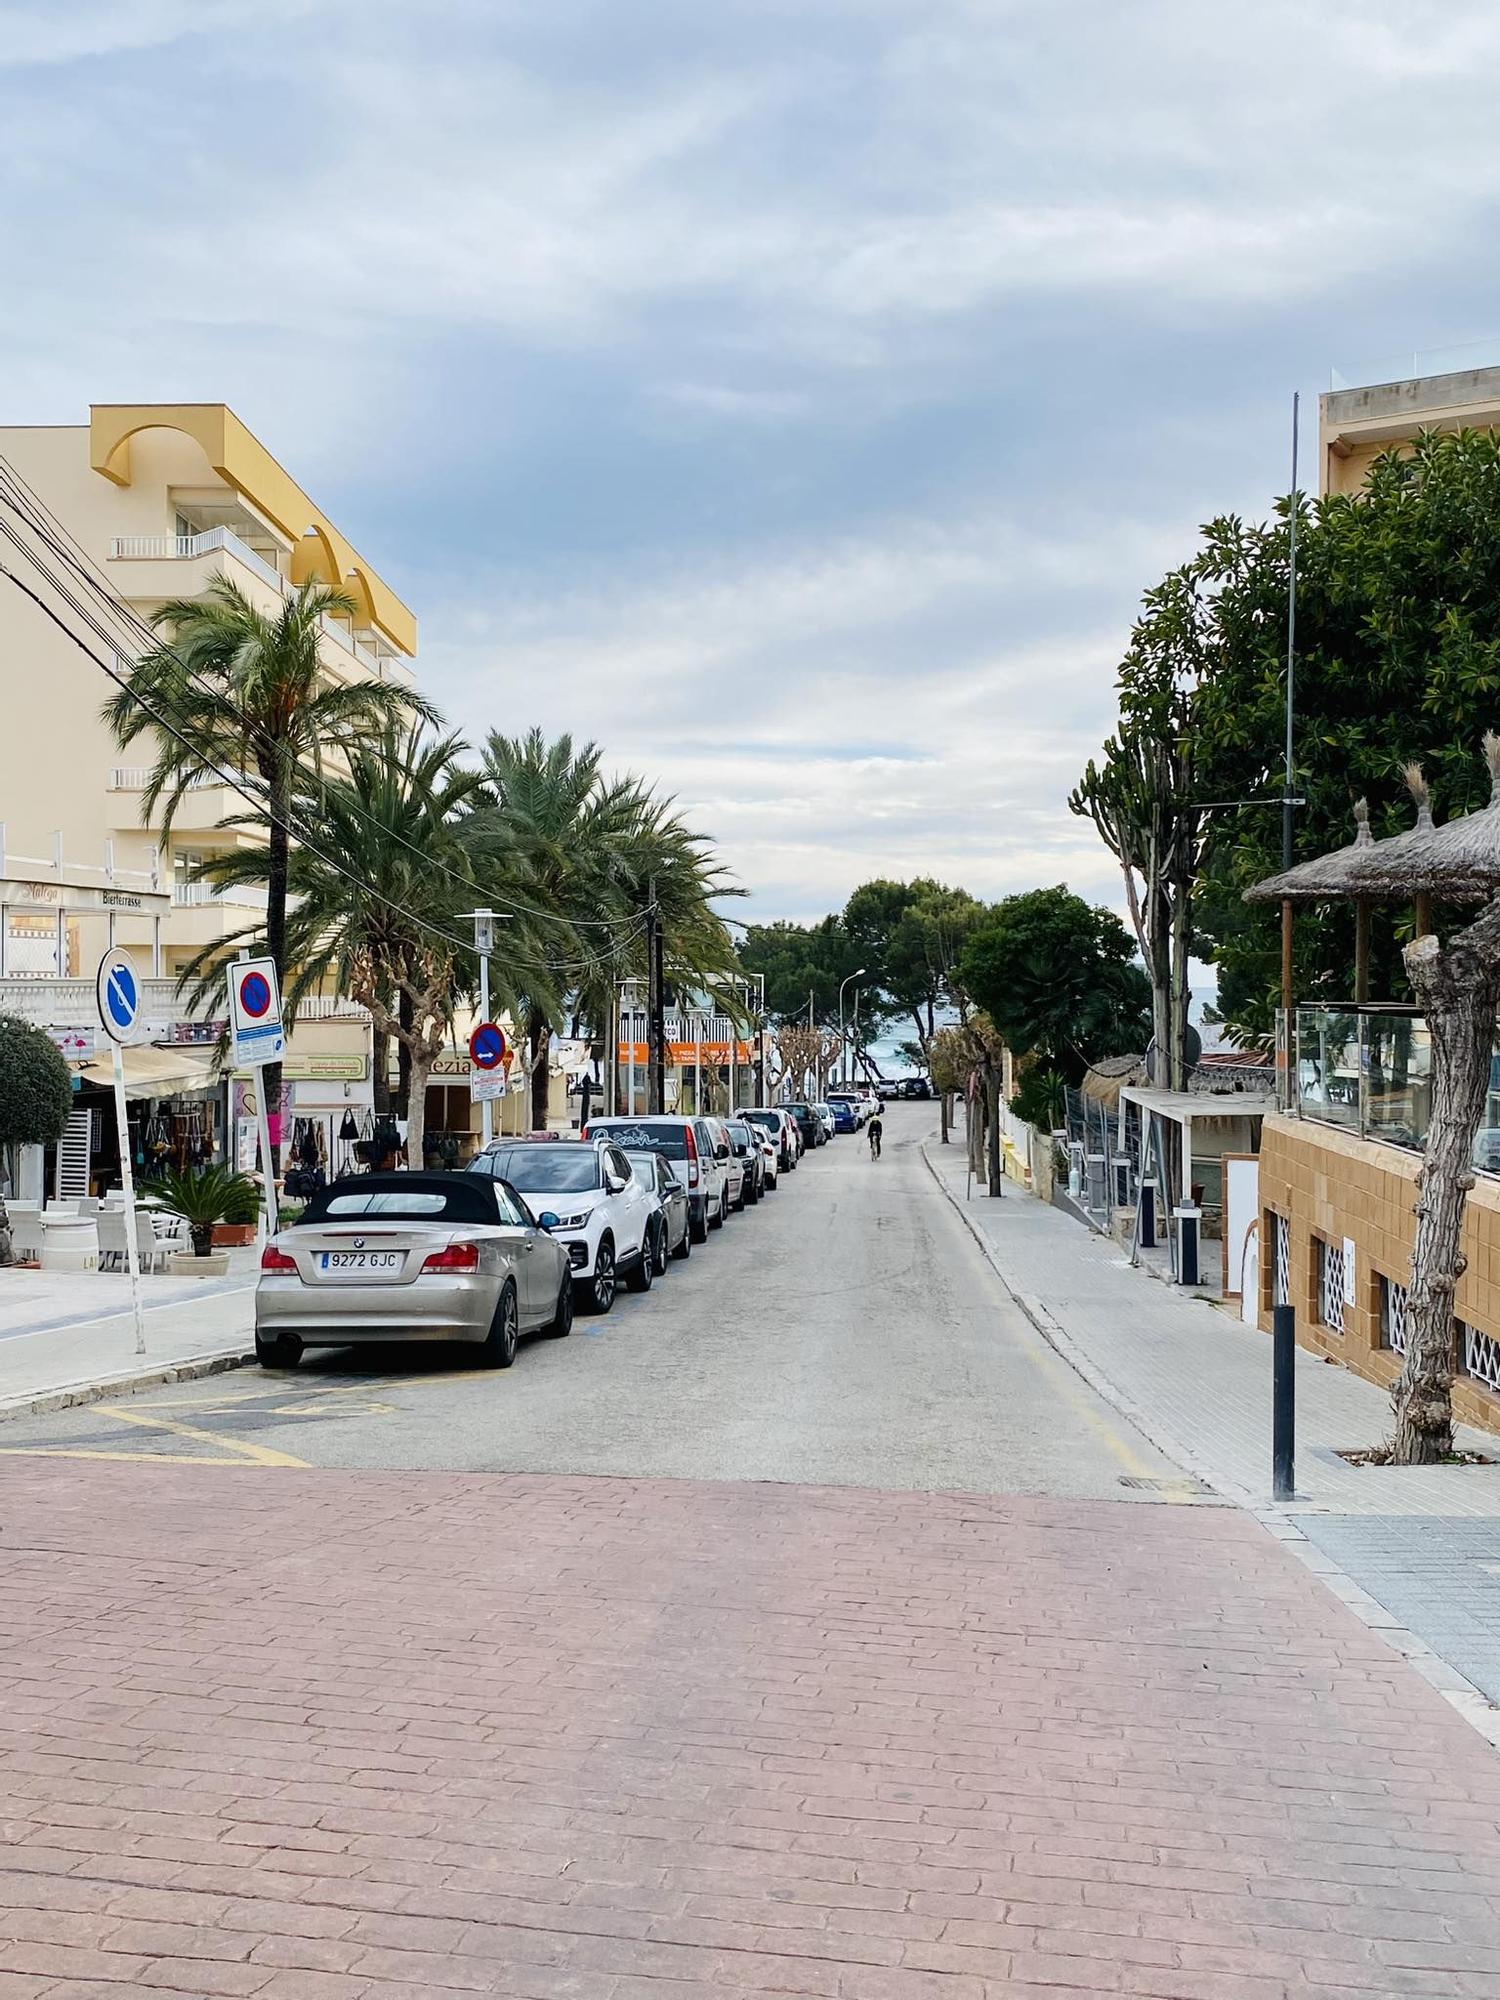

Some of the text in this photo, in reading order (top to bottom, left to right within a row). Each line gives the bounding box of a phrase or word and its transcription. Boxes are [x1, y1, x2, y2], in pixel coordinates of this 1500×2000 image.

[103, 890, 141, 908] Bierterrasse
[332, 1253, 396, 1267] 9272 GJC
